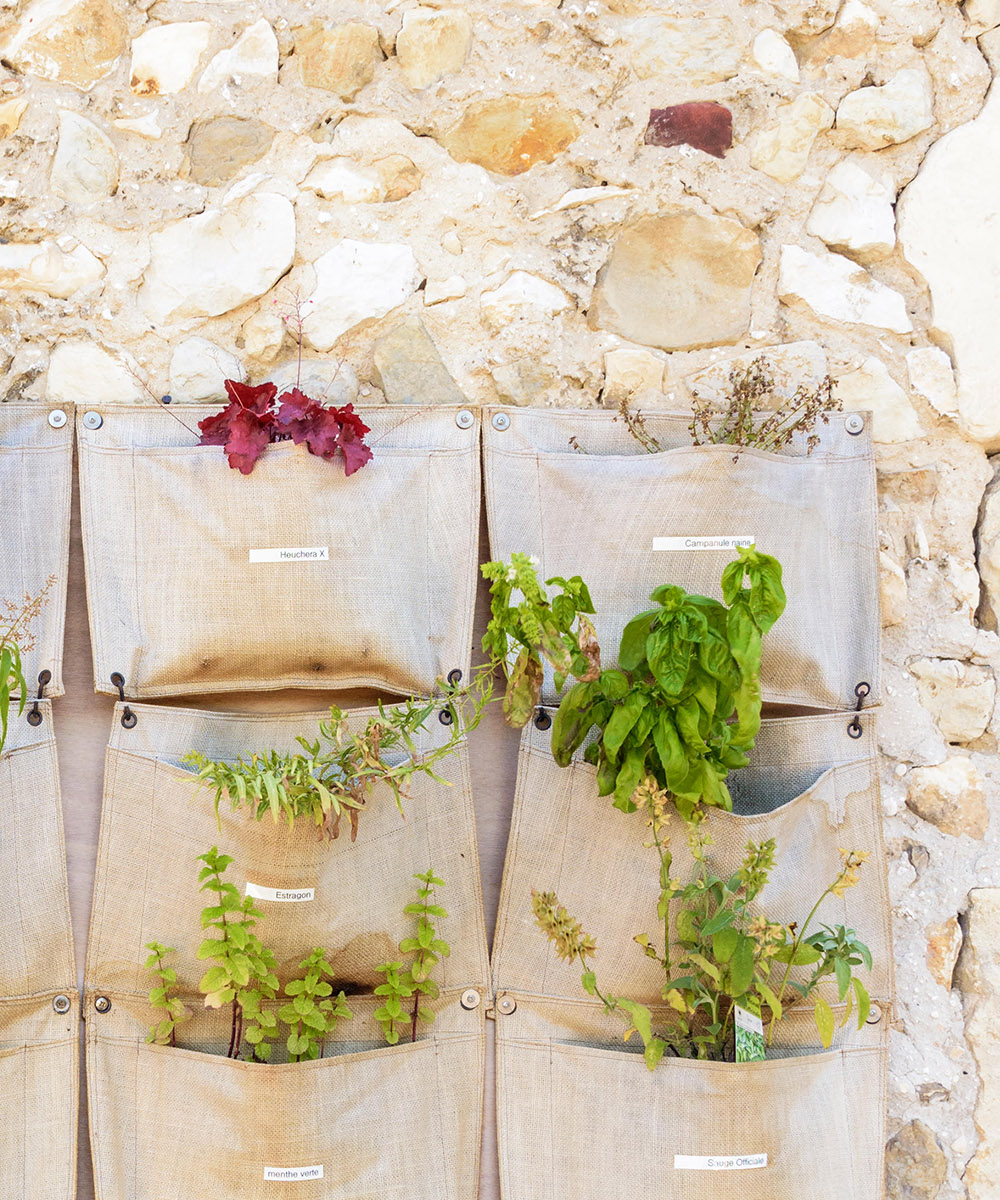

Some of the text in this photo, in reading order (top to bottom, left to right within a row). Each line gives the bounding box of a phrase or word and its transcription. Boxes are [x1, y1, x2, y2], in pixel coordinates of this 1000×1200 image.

[685, 539, 730, 548] Campanule
[280, 549, 325, 559] Heuchera X
[276, 891, 312, 900] Estragon
[267, 1169, 319, 1178] menthe verte
